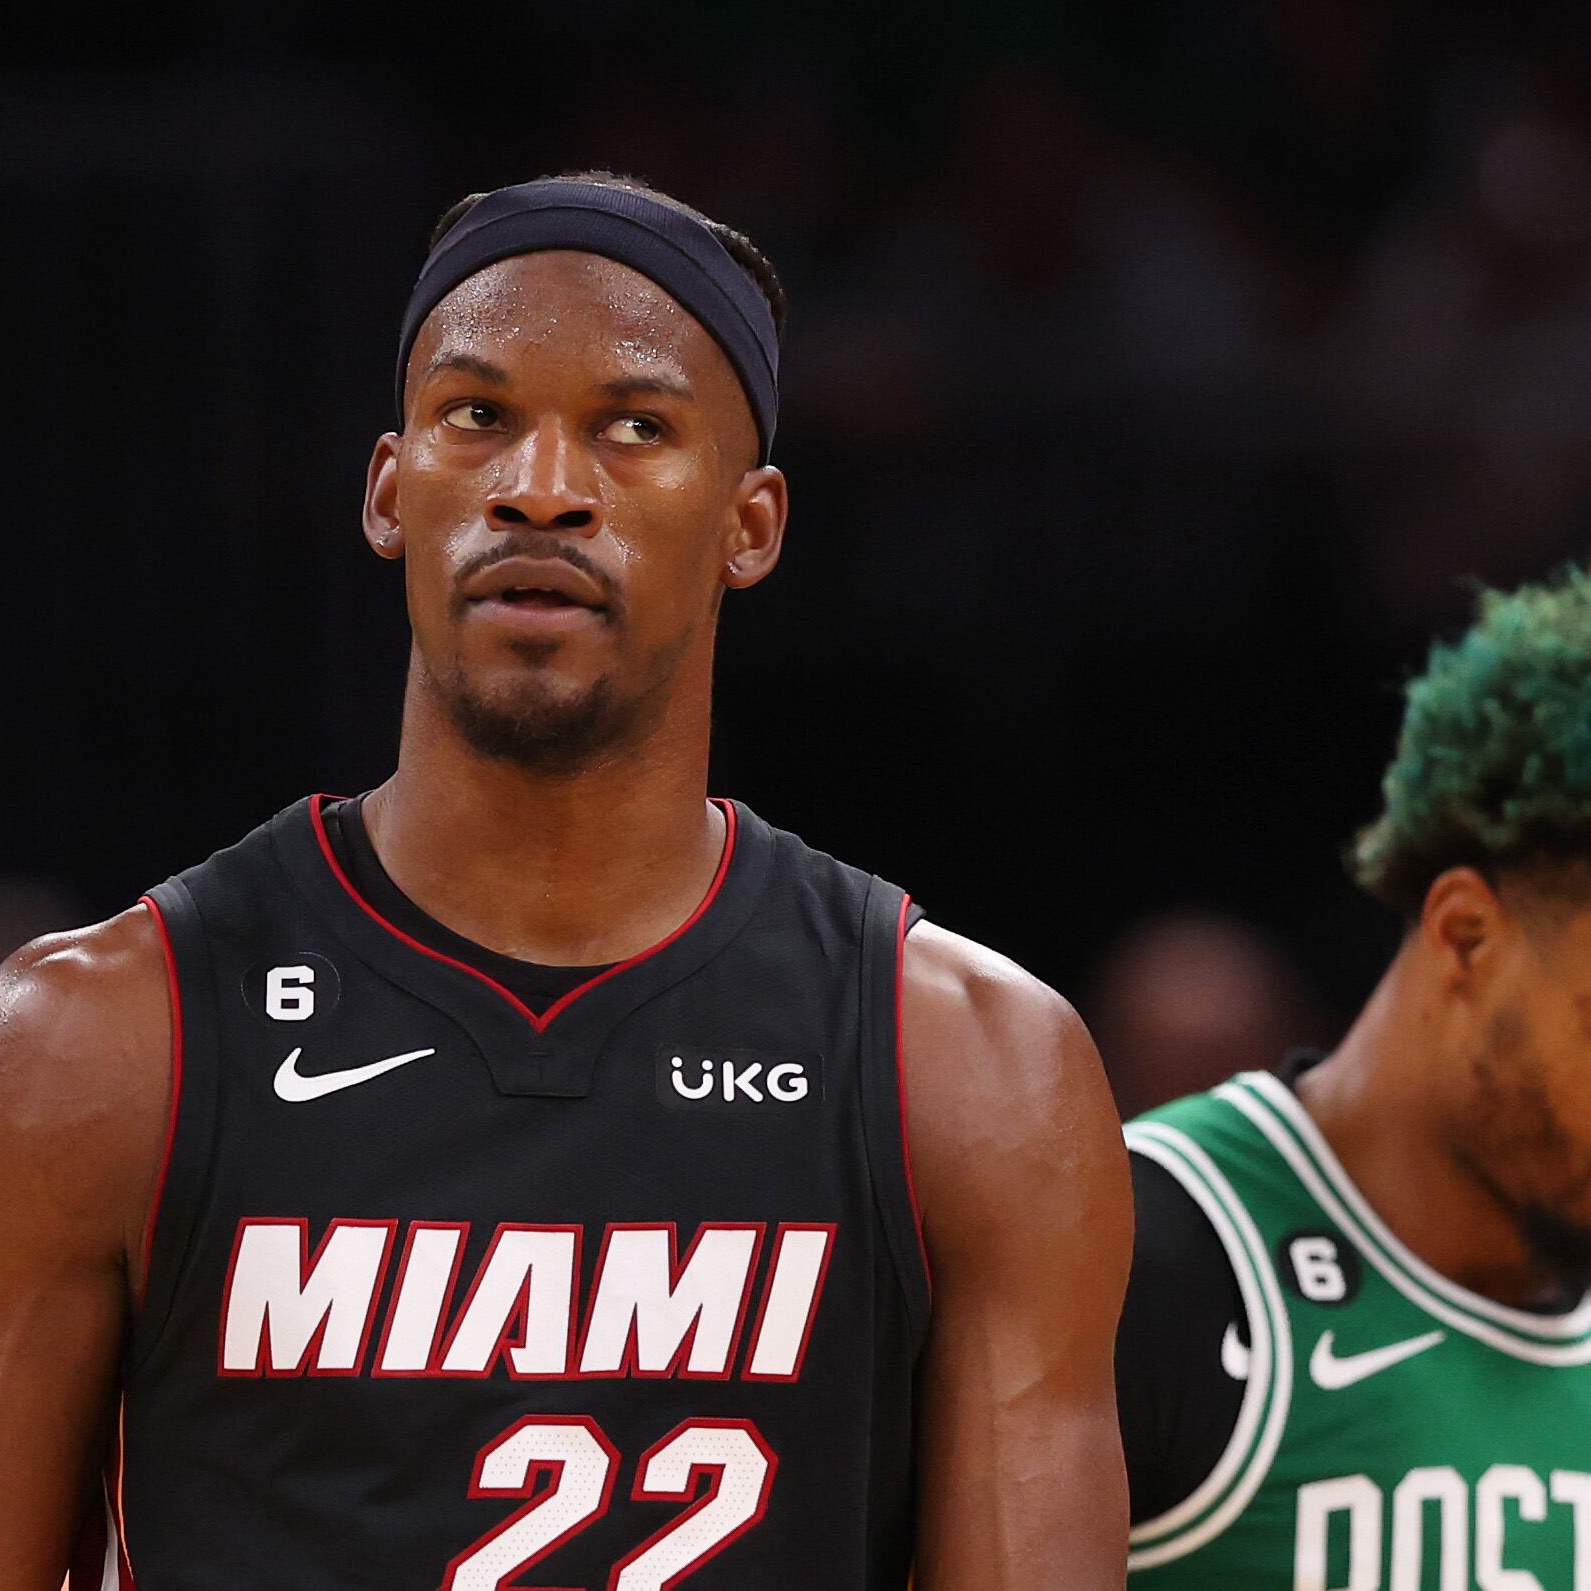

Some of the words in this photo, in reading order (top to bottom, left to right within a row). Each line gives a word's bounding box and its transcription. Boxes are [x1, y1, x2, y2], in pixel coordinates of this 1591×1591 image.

[266, 965, 315, 1021] 6
[217, 1217, 837, 1382] MIAMI
[1289, 1236, 1347, 1300] 6
